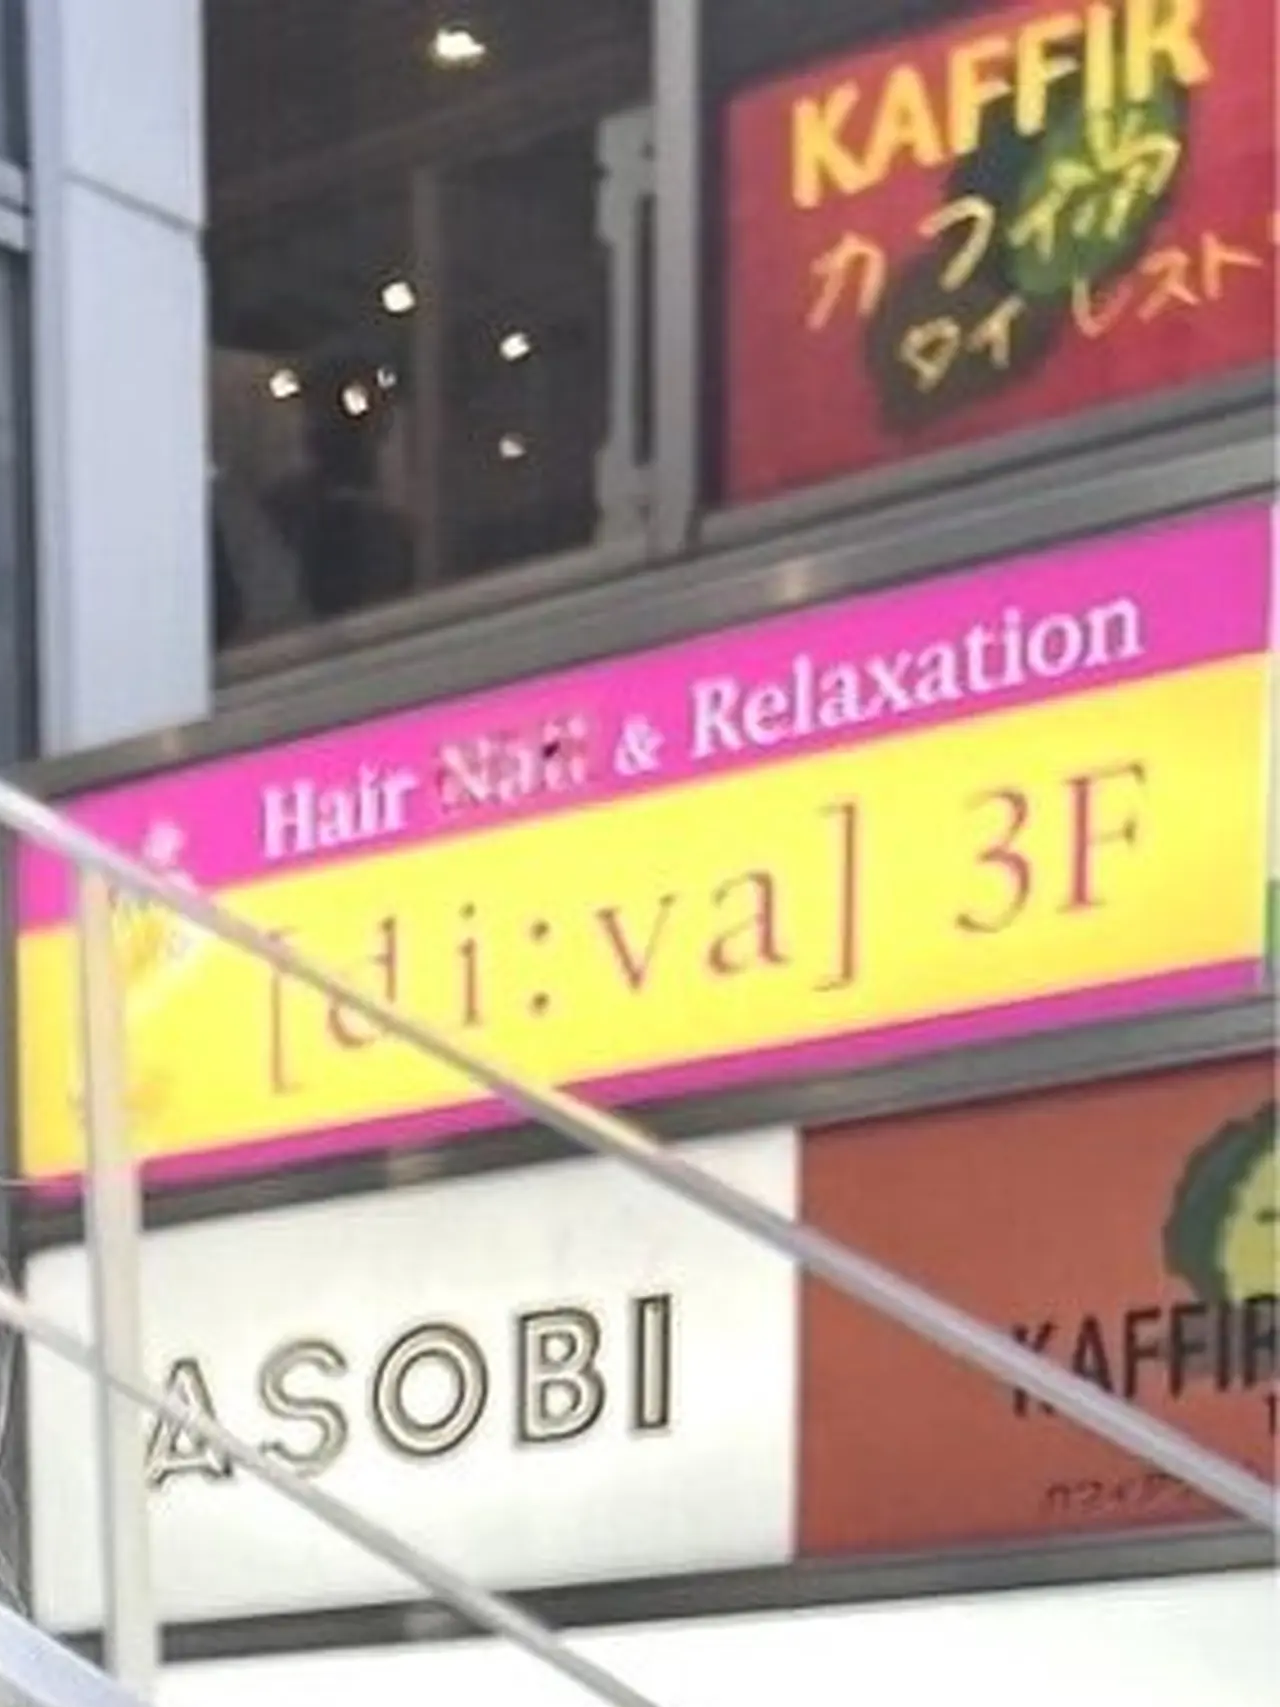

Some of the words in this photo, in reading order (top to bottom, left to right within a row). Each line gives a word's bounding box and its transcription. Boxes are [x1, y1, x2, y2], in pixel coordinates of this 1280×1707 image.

[791, 0, 1211, 208] KAFFIR
[260, 759, 419, 860] Hair
[612, 714, 666, 777] &
[690, 596, 1144, 760] Relaxation
[954, 762, 1147, 934] 3F
[144, 1292, 674, 1490] ASOBI
